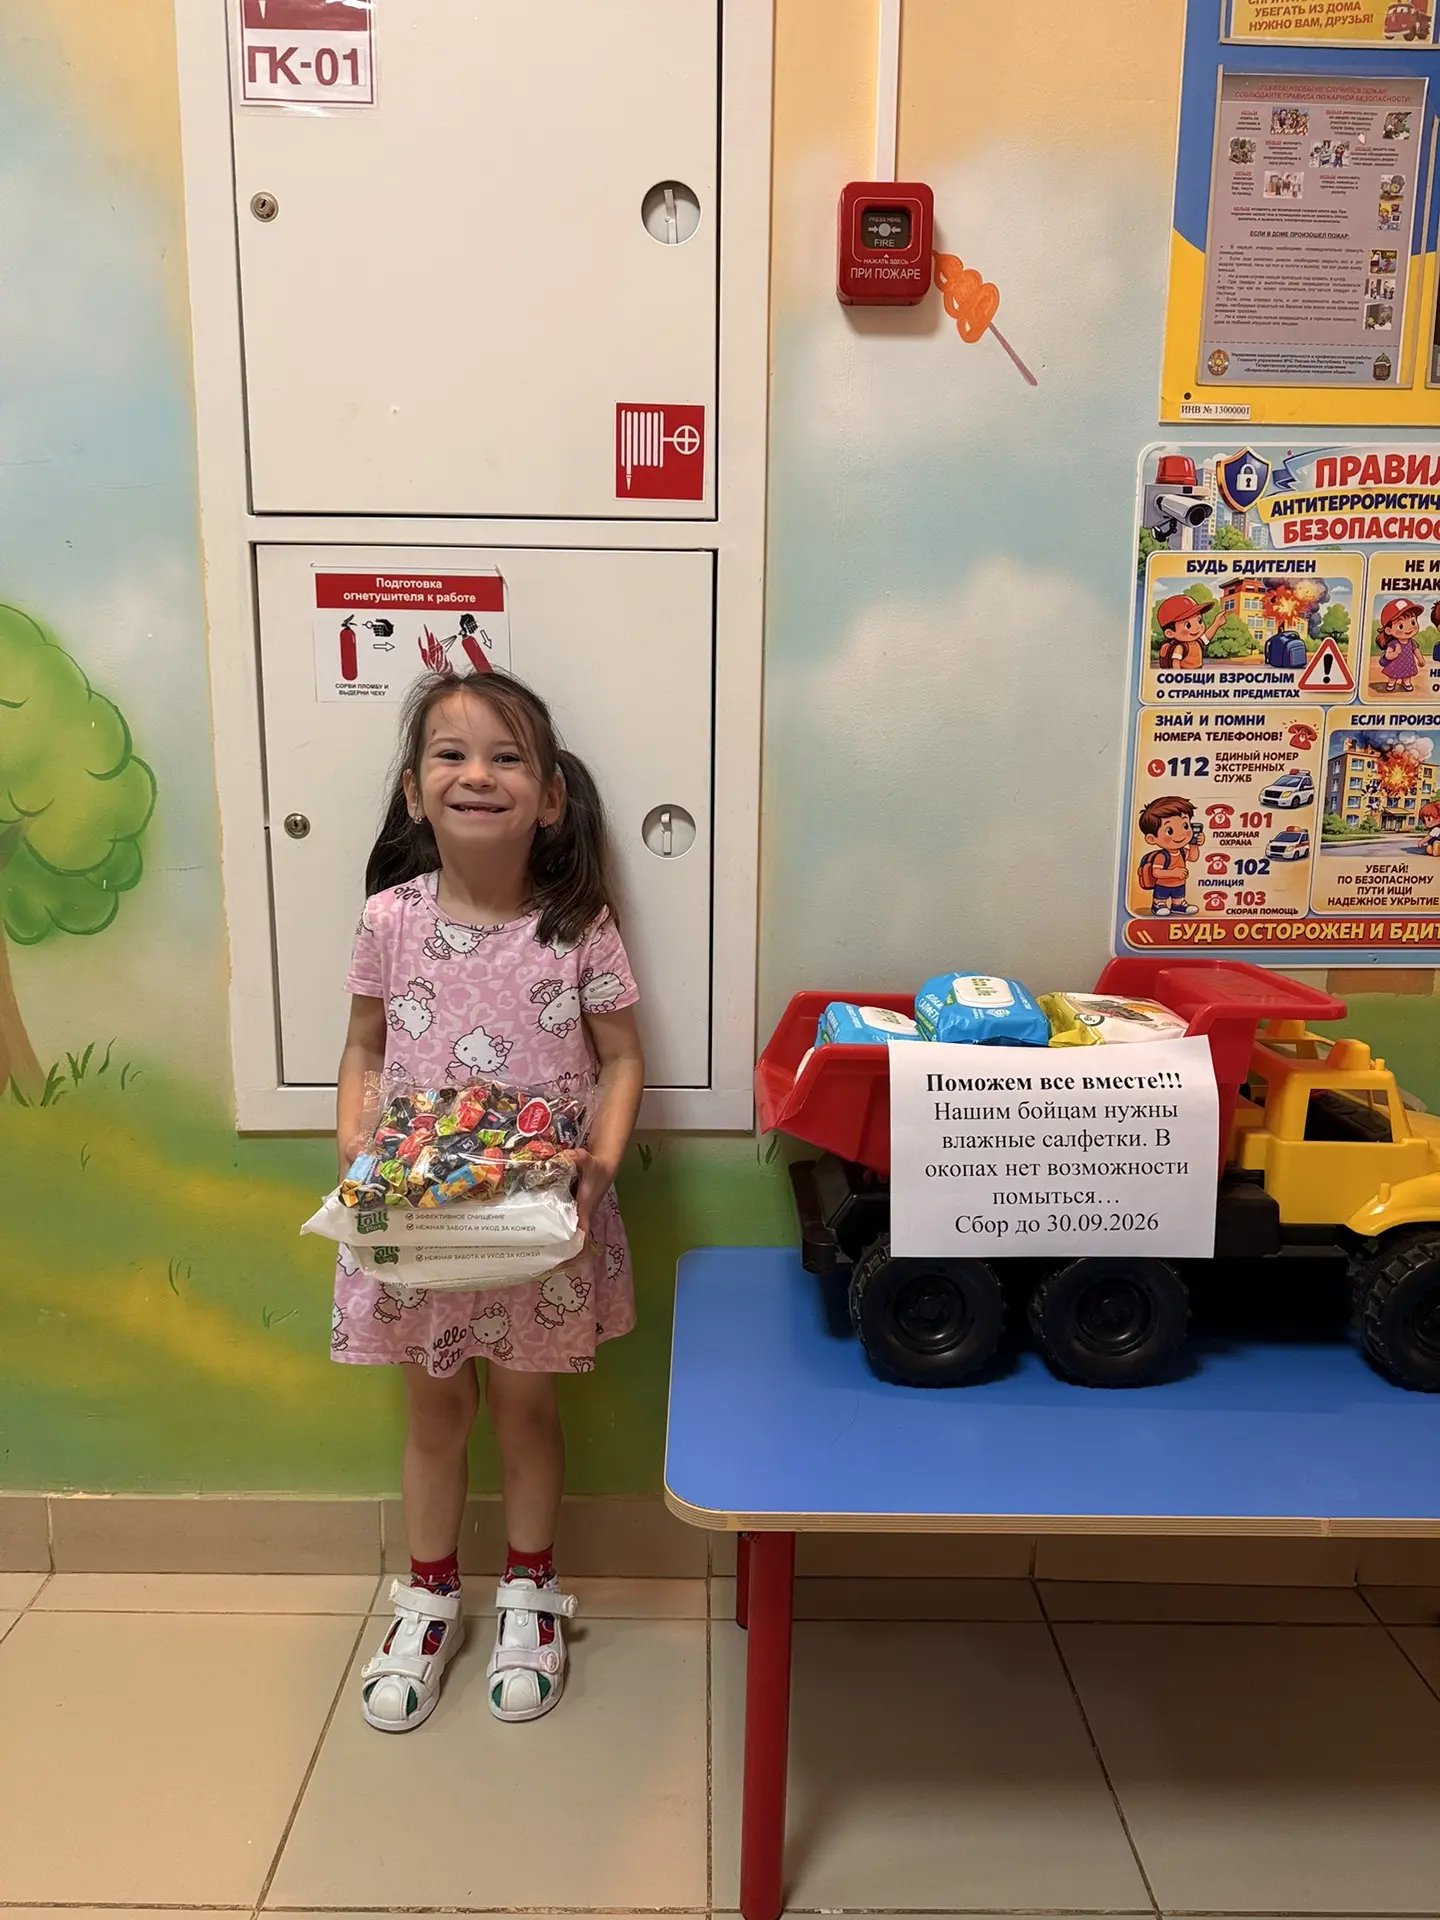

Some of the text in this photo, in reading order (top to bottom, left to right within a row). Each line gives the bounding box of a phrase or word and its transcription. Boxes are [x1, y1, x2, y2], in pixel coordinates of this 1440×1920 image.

[1255, 5, 1306, 17] УБЕГАТЬ
[1309, 4, 1324, 14] ИЗ
[1326, 2, 1361, 14] ДОМА
[1249, 14, 1374, 31] НУЖНО ВАМ, ДРУЗЬЯ!
[247, 45, 360, 86] ПК-01
[874, 238, 895, 248] FIRE
[850, 268, 920, 280] ПРИ ПОЖАРЕ
[1182, 406, 1250, 414] ИНВ № 13000001
[1270, 492, 1440, 517] АНТИТЕРРОРИСТИЧ
[1186, 559, 1316, 574] БУДЬ БДИТЕЛЕН
[1405, 560, 1425, 572] НЕ
[376, 578, 443, 589] Подготовка
[1381, 578, 1440, 591] НЕЗНАК
[343, 592, 476, 604] огнетушителя к работе
[1156, 672, 1295, 686] СООБЩИ ВЗРОСЛЫМ
[1156, 688, 1300, 699] О СТРАННЫХ ПРЕДМЕТАХ
[1155, 712, 1266, 726] ЗНАЙ И ПОМНИ
[1350, 714, 1440, 726] ЕСЛИ ПРОИЗО
[1154, 731, 1283, 742] НОМЕРА ТЕЛЕФОНОВ!
[1215, 750, 1299, 762] ЕДИНЫЙ НОМЕР
[1167, 756, 1210, 777] 112
[1214, 763, 1285, 772] ЭКСТРЕННЫХ
[1214, 774, 1252, 783] СЛУЖБ
[1239, 812, 1273, 828] 101
[1212, 831, 1260, 839] ПОЖАРНАЯ
[1220, 838, 1252, 846] ОХРАНА
[1234, 858, 1270, 875] 102
[1366, 863, 1409, 874] УБЕГАЙ!
[1198, 878, 1244, 888] ПОЛИЦИЯ
[1337, 876, 1434, 884] ПО БЕЗОПАСНОМУ
[1356, 886, 1412, 896] ПУТИ ИЩИ
[1234, 891, 1266, 906] 103
[1328, 896, 1440, 907] НАДЕЖНОЕ УКРЫТИЕ
[1226, 908, 1299, 917] СКОРАЯ ПОМОЩЬ
[1169, 923, 1226, 940] БУДЬ
[1233, 923, 1362, 940] ОСТОРОЖЕН
[1370, 922, 1384, 939] И
[926, 1072, 1183, 1092] Поможем все вместе!!!
[934, 1100, 1178, 1123] Нашим бойцам нужны
[942, 1128, 1171, 1152] влажные салфетки. В
[925, 1161, 1189, 1178] окопах нет возможности
[446, 1224, 473, 1232] ЗАБОТА
[511, 1224, 536, 1232] КОЖЕЙ
[954, 1212, 1160, 1238] Сбор до 30.09.2026
